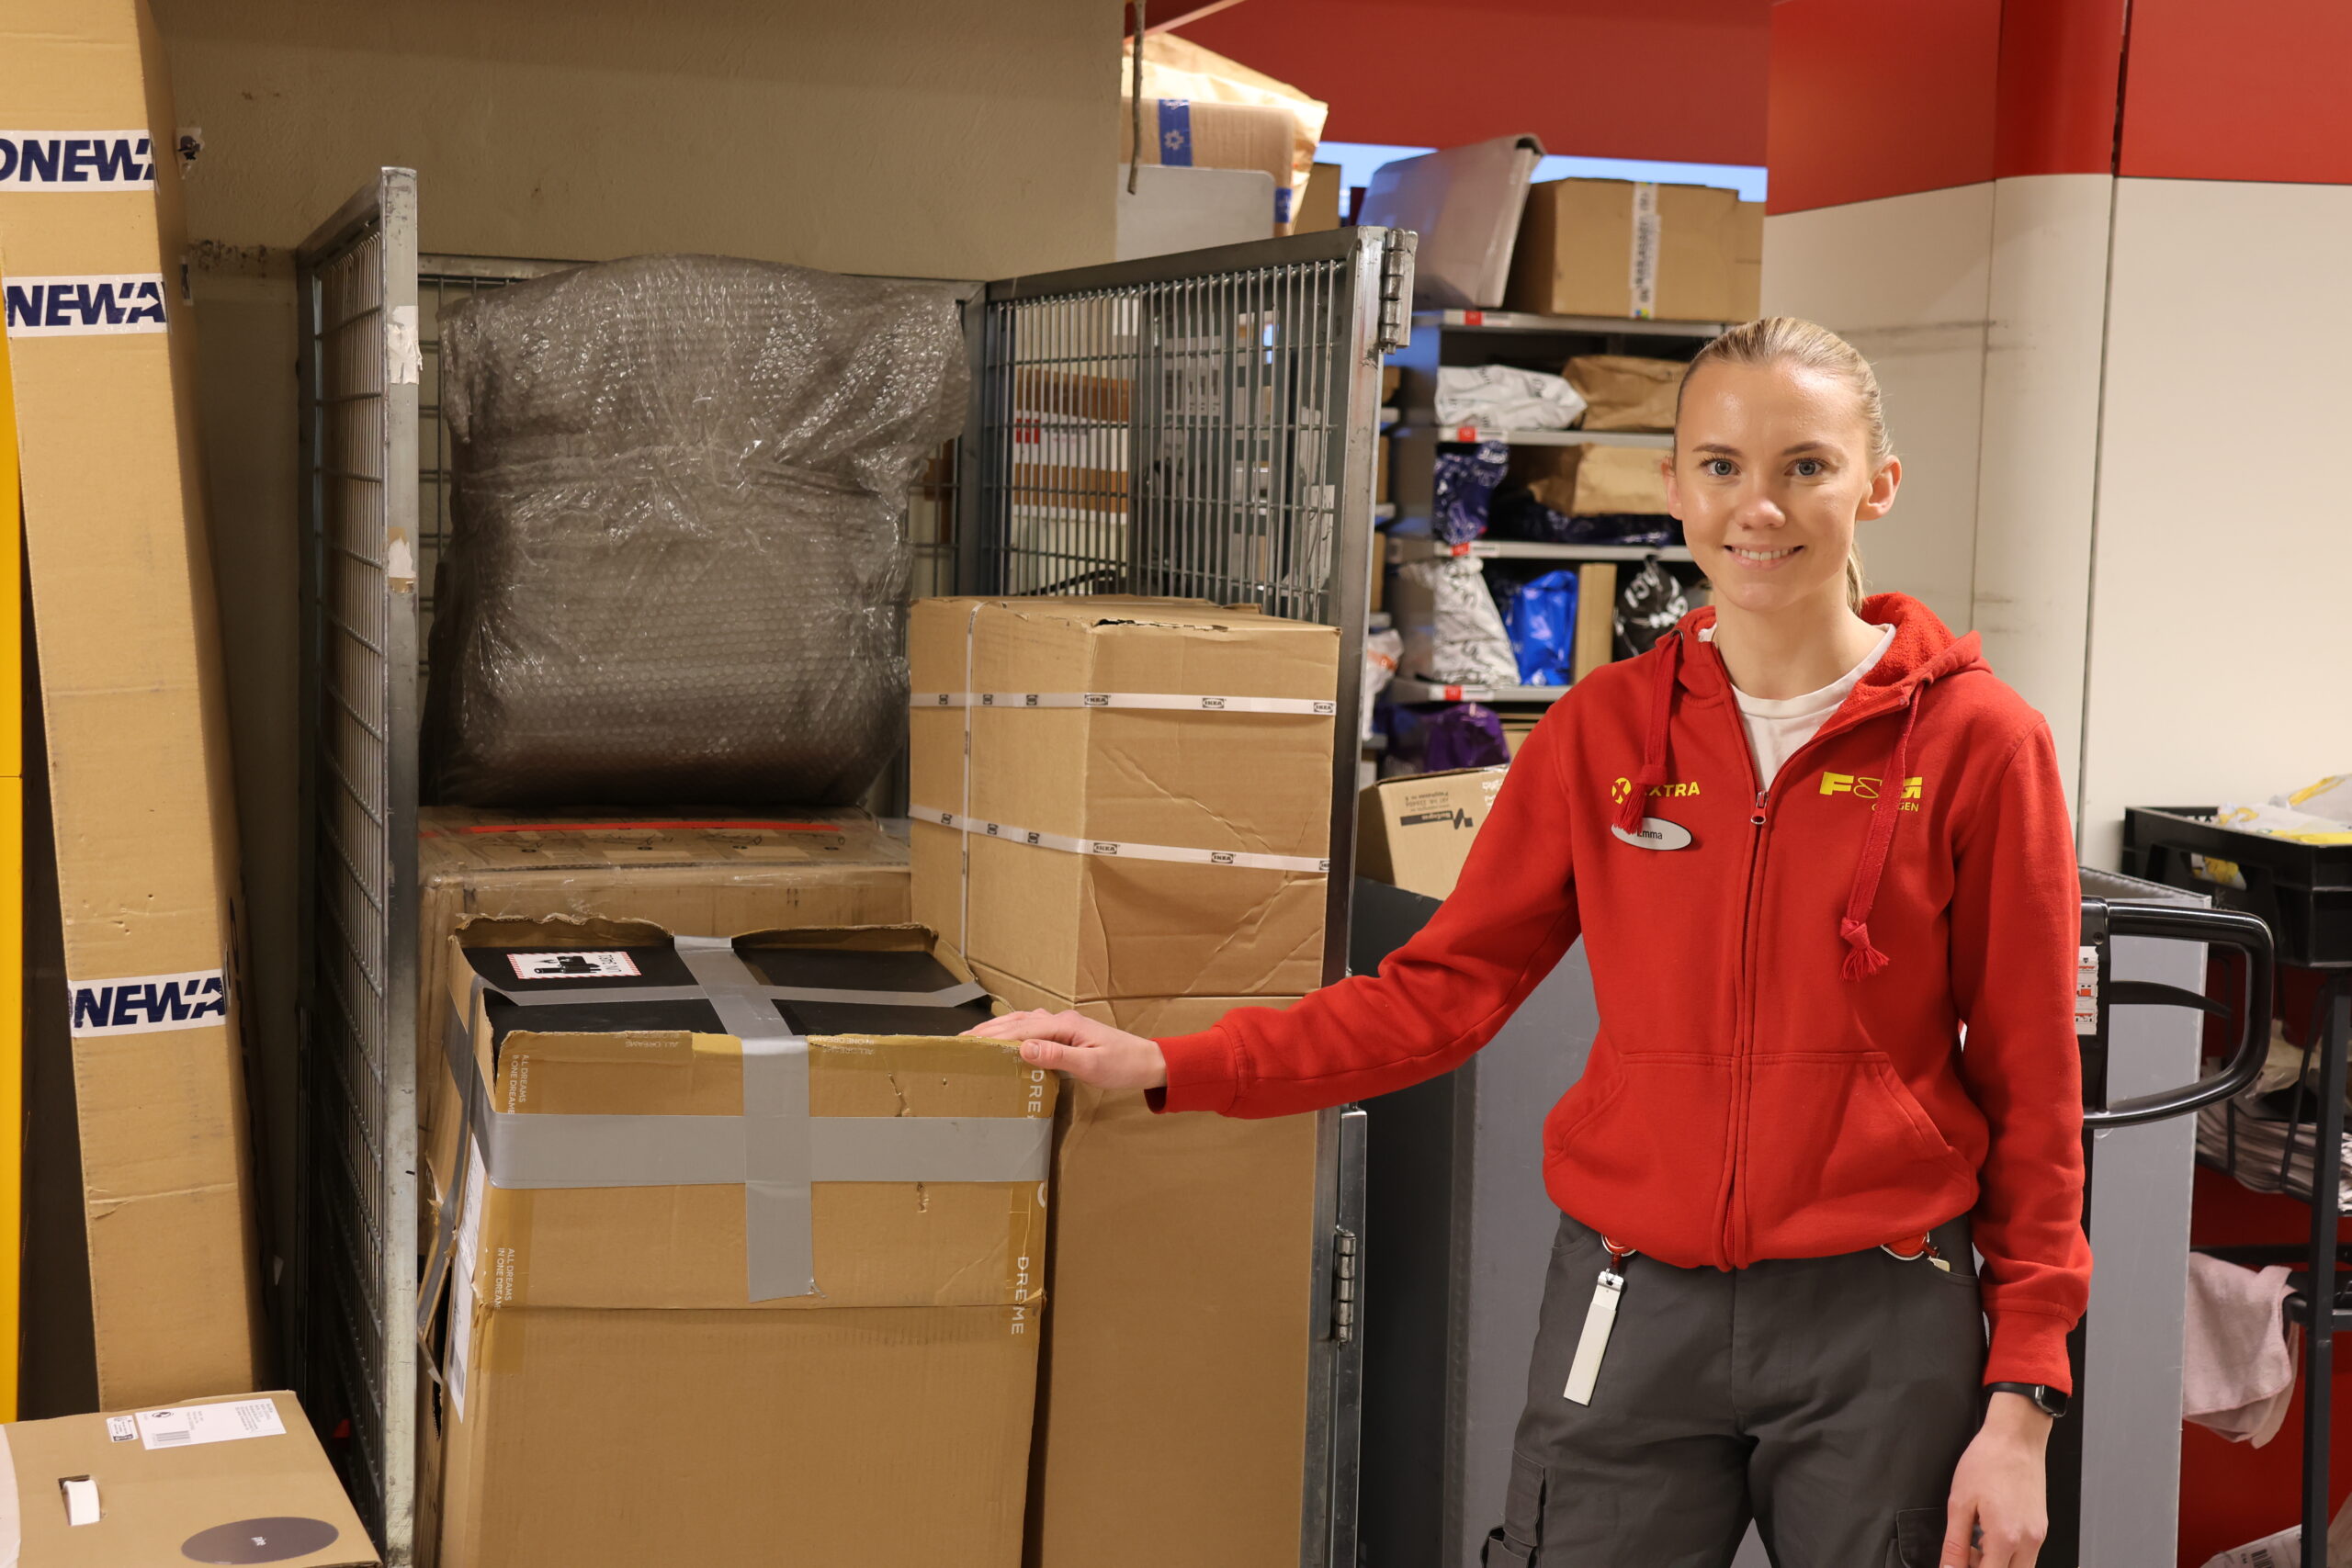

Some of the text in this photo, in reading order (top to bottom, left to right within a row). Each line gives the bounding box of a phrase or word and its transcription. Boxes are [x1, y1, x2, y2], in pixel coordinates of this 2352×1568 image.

[1645, 782, 1700, 797] XTRA
[510, 1060, 519, 1079] ONE
[518, 1067, 528, 1103] DREAMS
[497, 1247, 505, 1257] IN
[496, 1258, 504, 1277] ONE
[504, 1248, 515, 1302] ALL DREAMS
[1011, 1257, 1030, 1336] DREME
